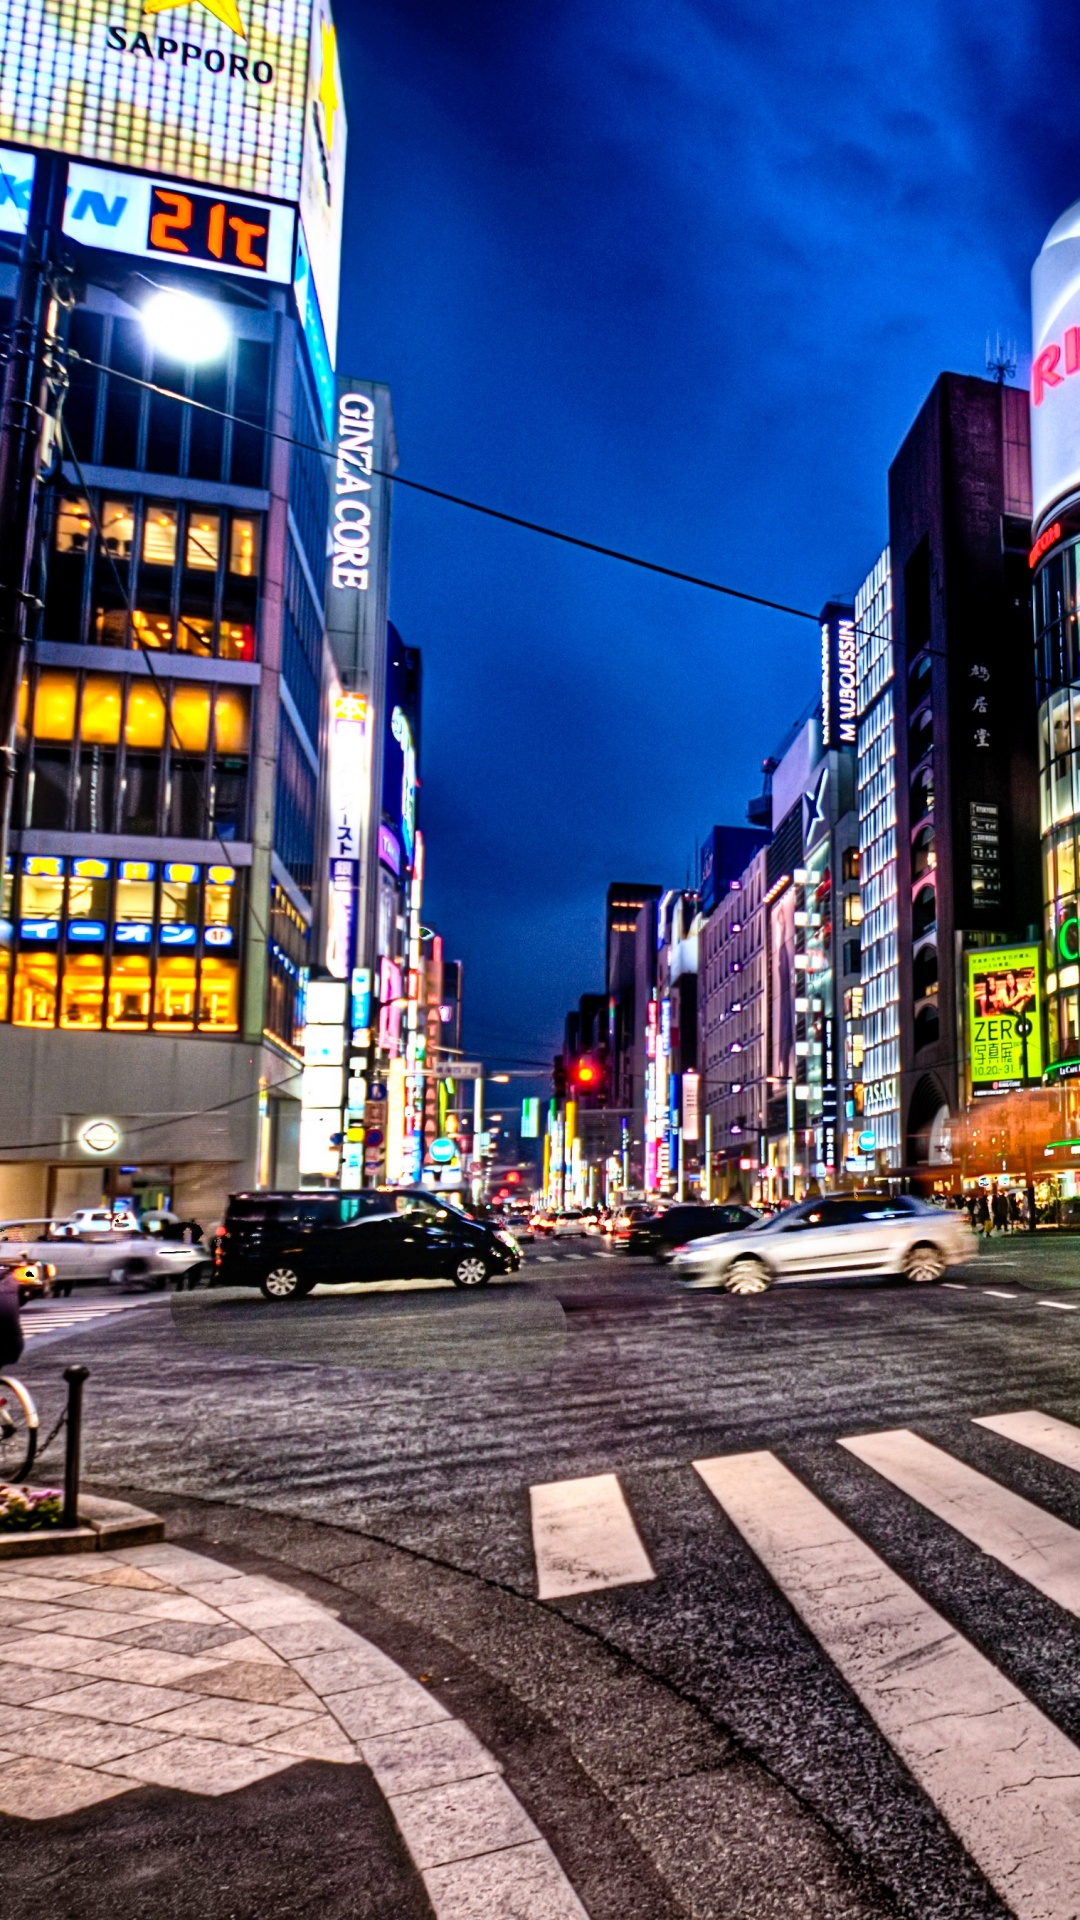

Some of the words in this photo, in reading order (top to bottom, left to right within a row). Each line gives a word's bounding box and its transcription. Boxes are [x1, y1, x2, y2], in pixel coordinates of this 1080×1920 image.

[105, 26, 274, 84] SAPPORO
[337, 393, 375, 494] GINZA
[332, 500, 371, 590] CORE
[838, 619, 856, 742] MAUBOUSSIN
[969, 664, 990, 747] 鳩居堂
[21, 921, 194, 942] イーオン
[974, 1043, 1013, 1065] 写真展
[863, 1077, 896, 1106] TASAKI
